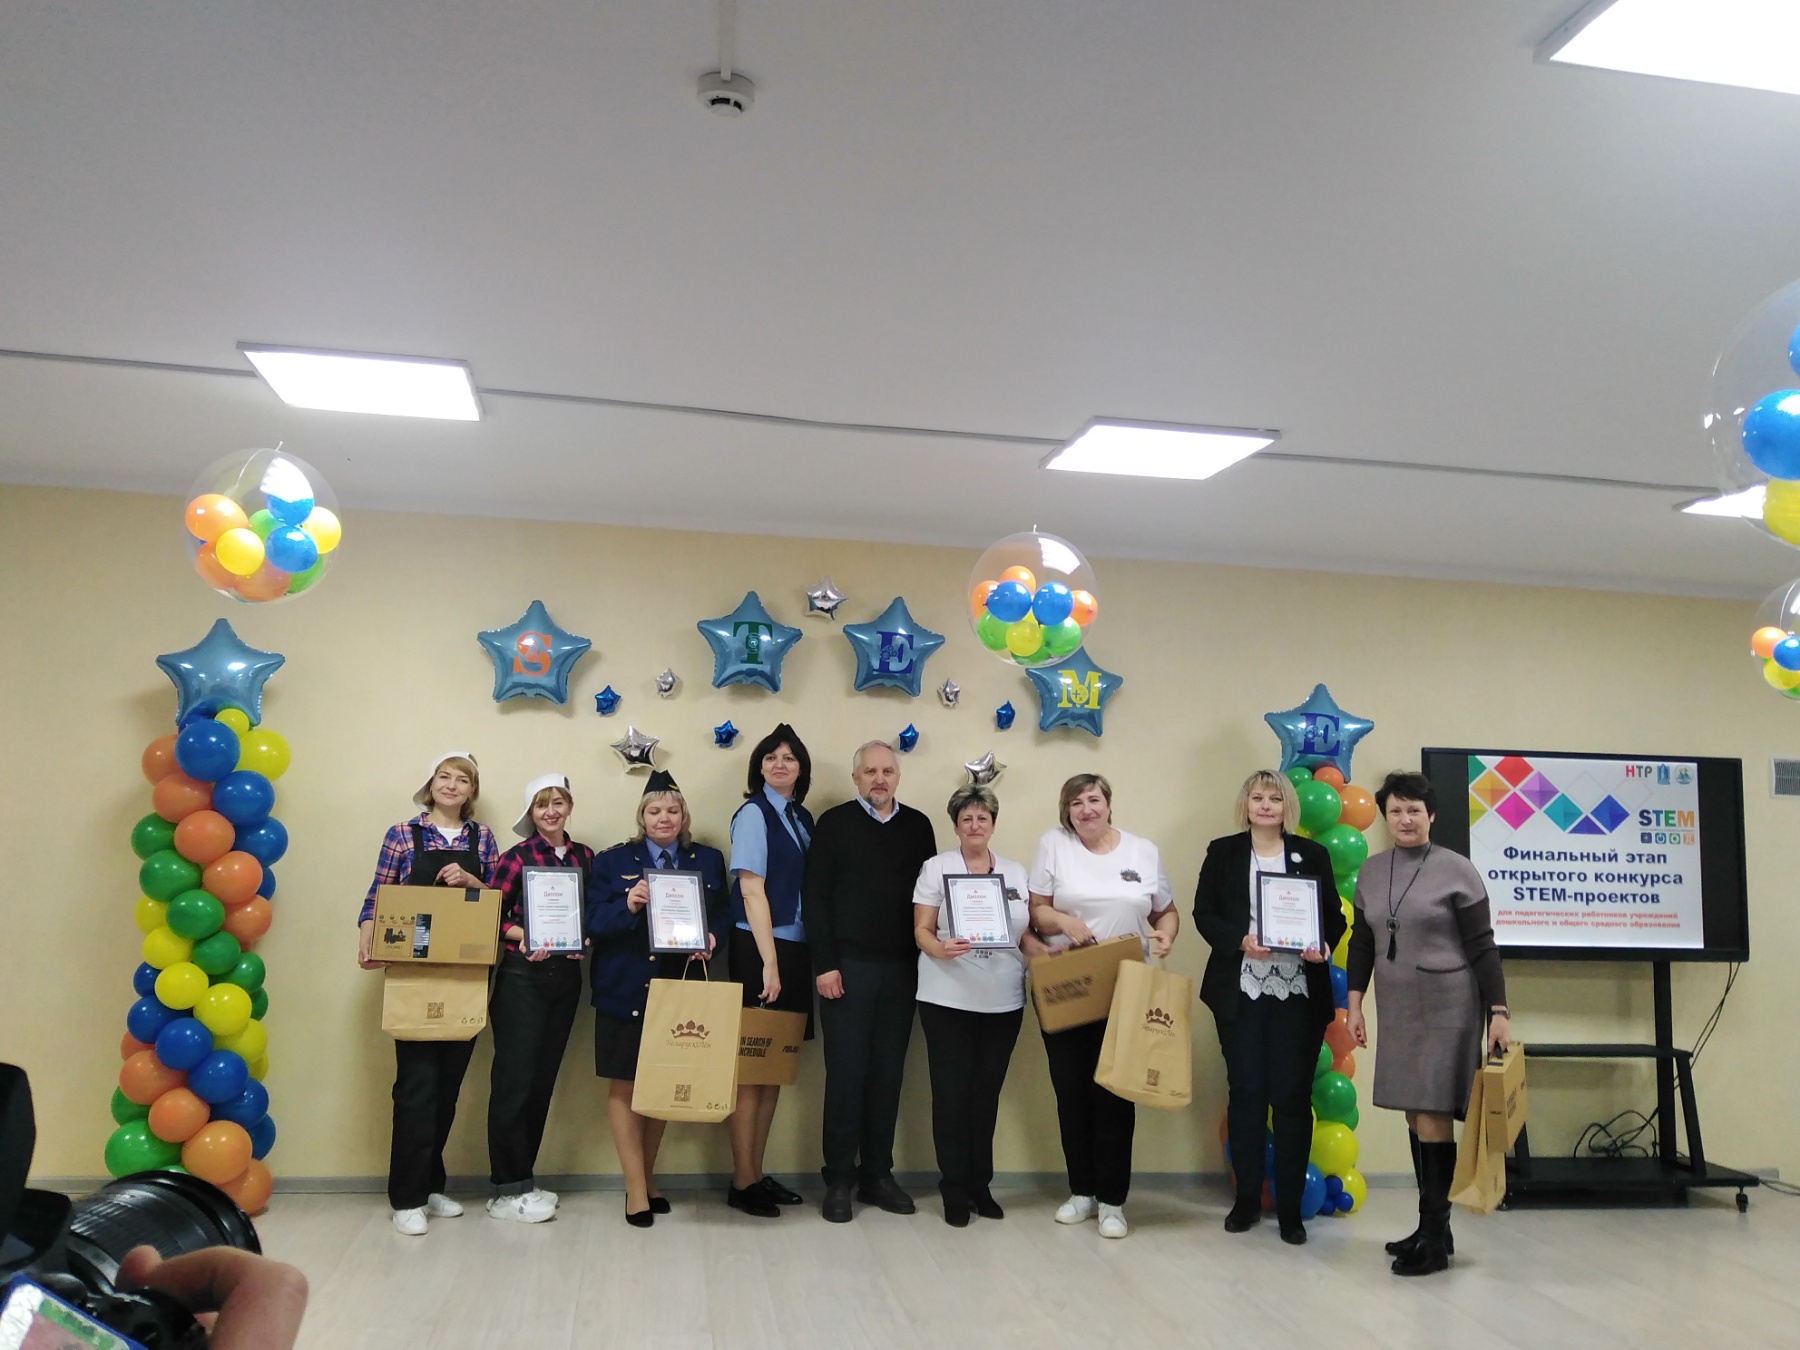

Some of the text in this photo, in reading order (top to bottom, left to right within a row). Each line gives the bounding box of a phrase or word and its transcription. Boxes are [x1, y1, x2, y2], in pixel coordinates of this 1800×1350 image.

[512, 621, 1102, 710] S T E M
[1297, 712, 1340, 757] E
[1625, 765, 1653, 778] HTP
[1638, 809, 1695, 828] STEM
[1503, 846, 1668, 865] Финальный этап
[1488, 868, 1684, 887] открытого конкурса
[1513, 886, 1661, 906] STEM-проектов
[1514, 910, 1579, 918] педагогических
[1581, 911, 1628, 919] работников
[1630, 911, 1678, 919] учреждений
[1559, 919, 1589, 927] общего
[1591, 920, 1628, 928] среднего
[1629, 921, 1681, 929] образования
[746, 1036, 766, 1047] SEARCH
[738, 1047, 767, 1058] INCREDIBLE
